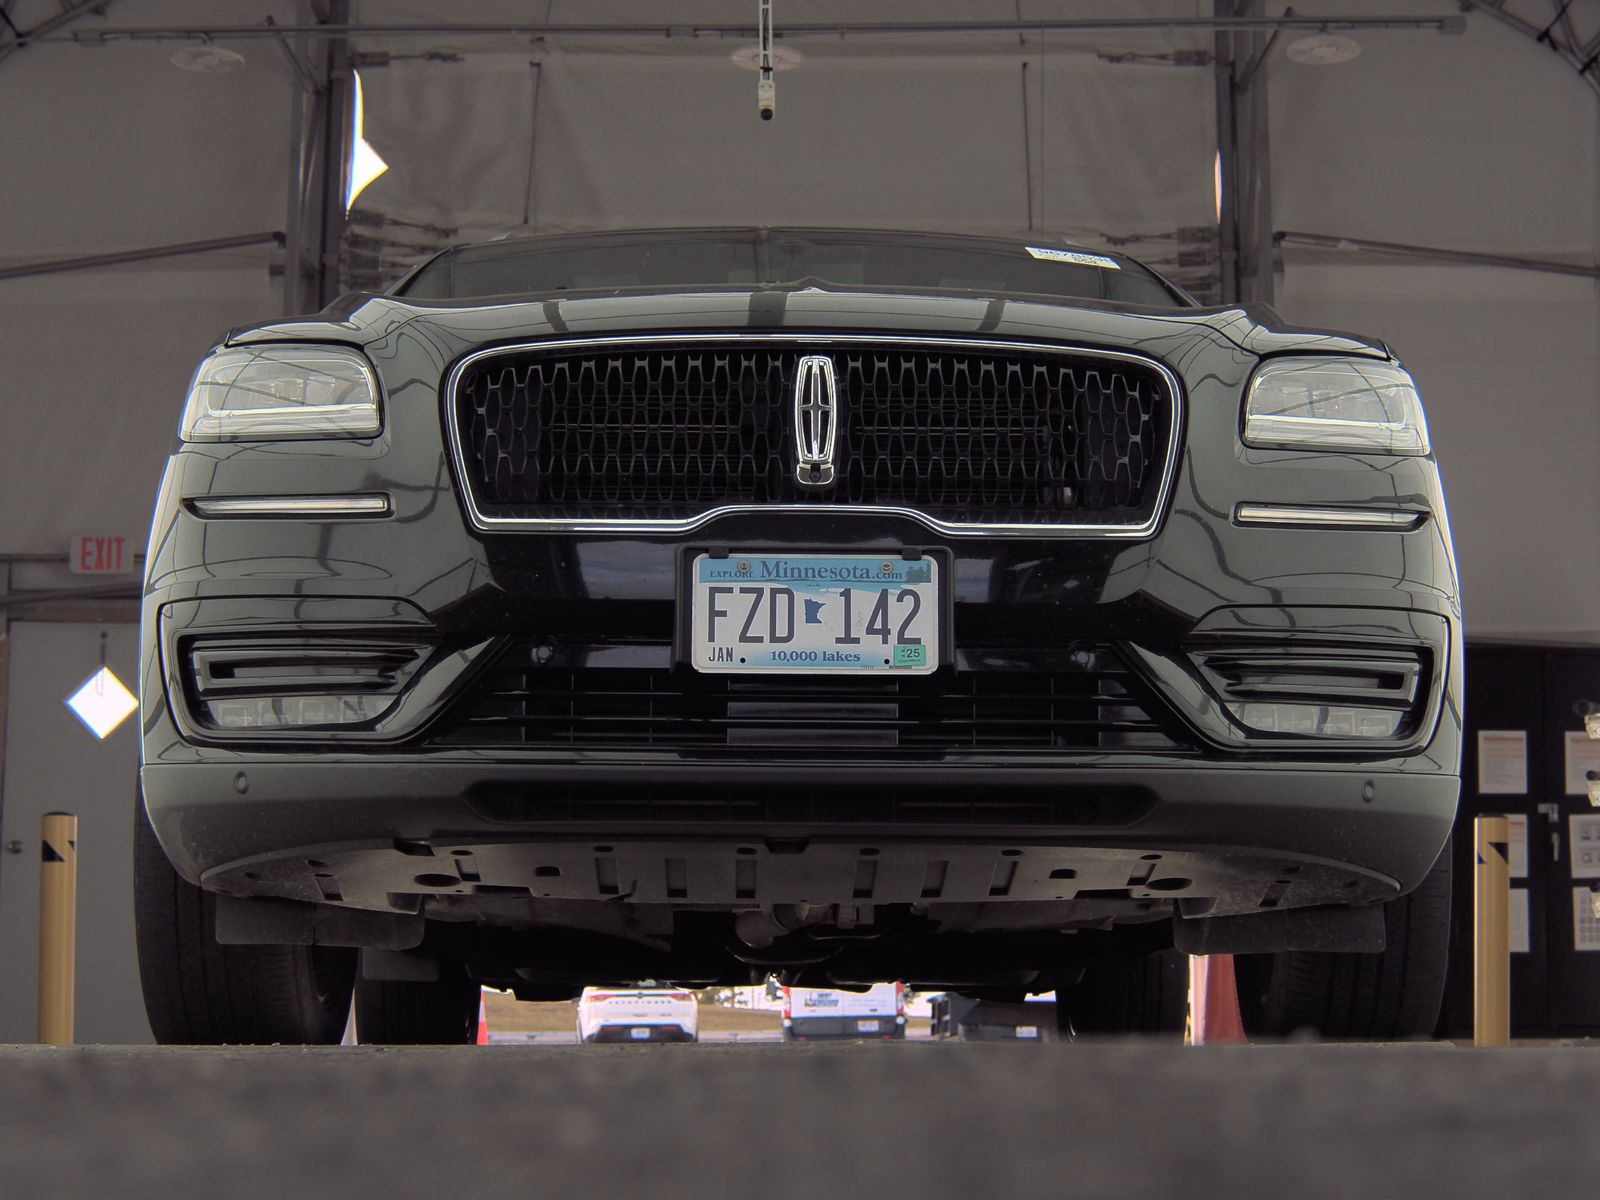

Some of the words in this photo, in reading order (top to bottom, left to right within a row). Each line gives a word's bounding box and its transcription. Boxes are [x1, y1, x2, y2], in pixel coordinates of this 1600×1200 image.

[81, 537, 126, 571] EXIT
[708, 586, 795, 644] FZD
[834, 588, 922, 644] 142
[708, 647, 734, 662] JAN
[770, 650, 818, 662] 10,000
[822, 651, 861, 662] lakes
[906, 648, 920, 659] 25
